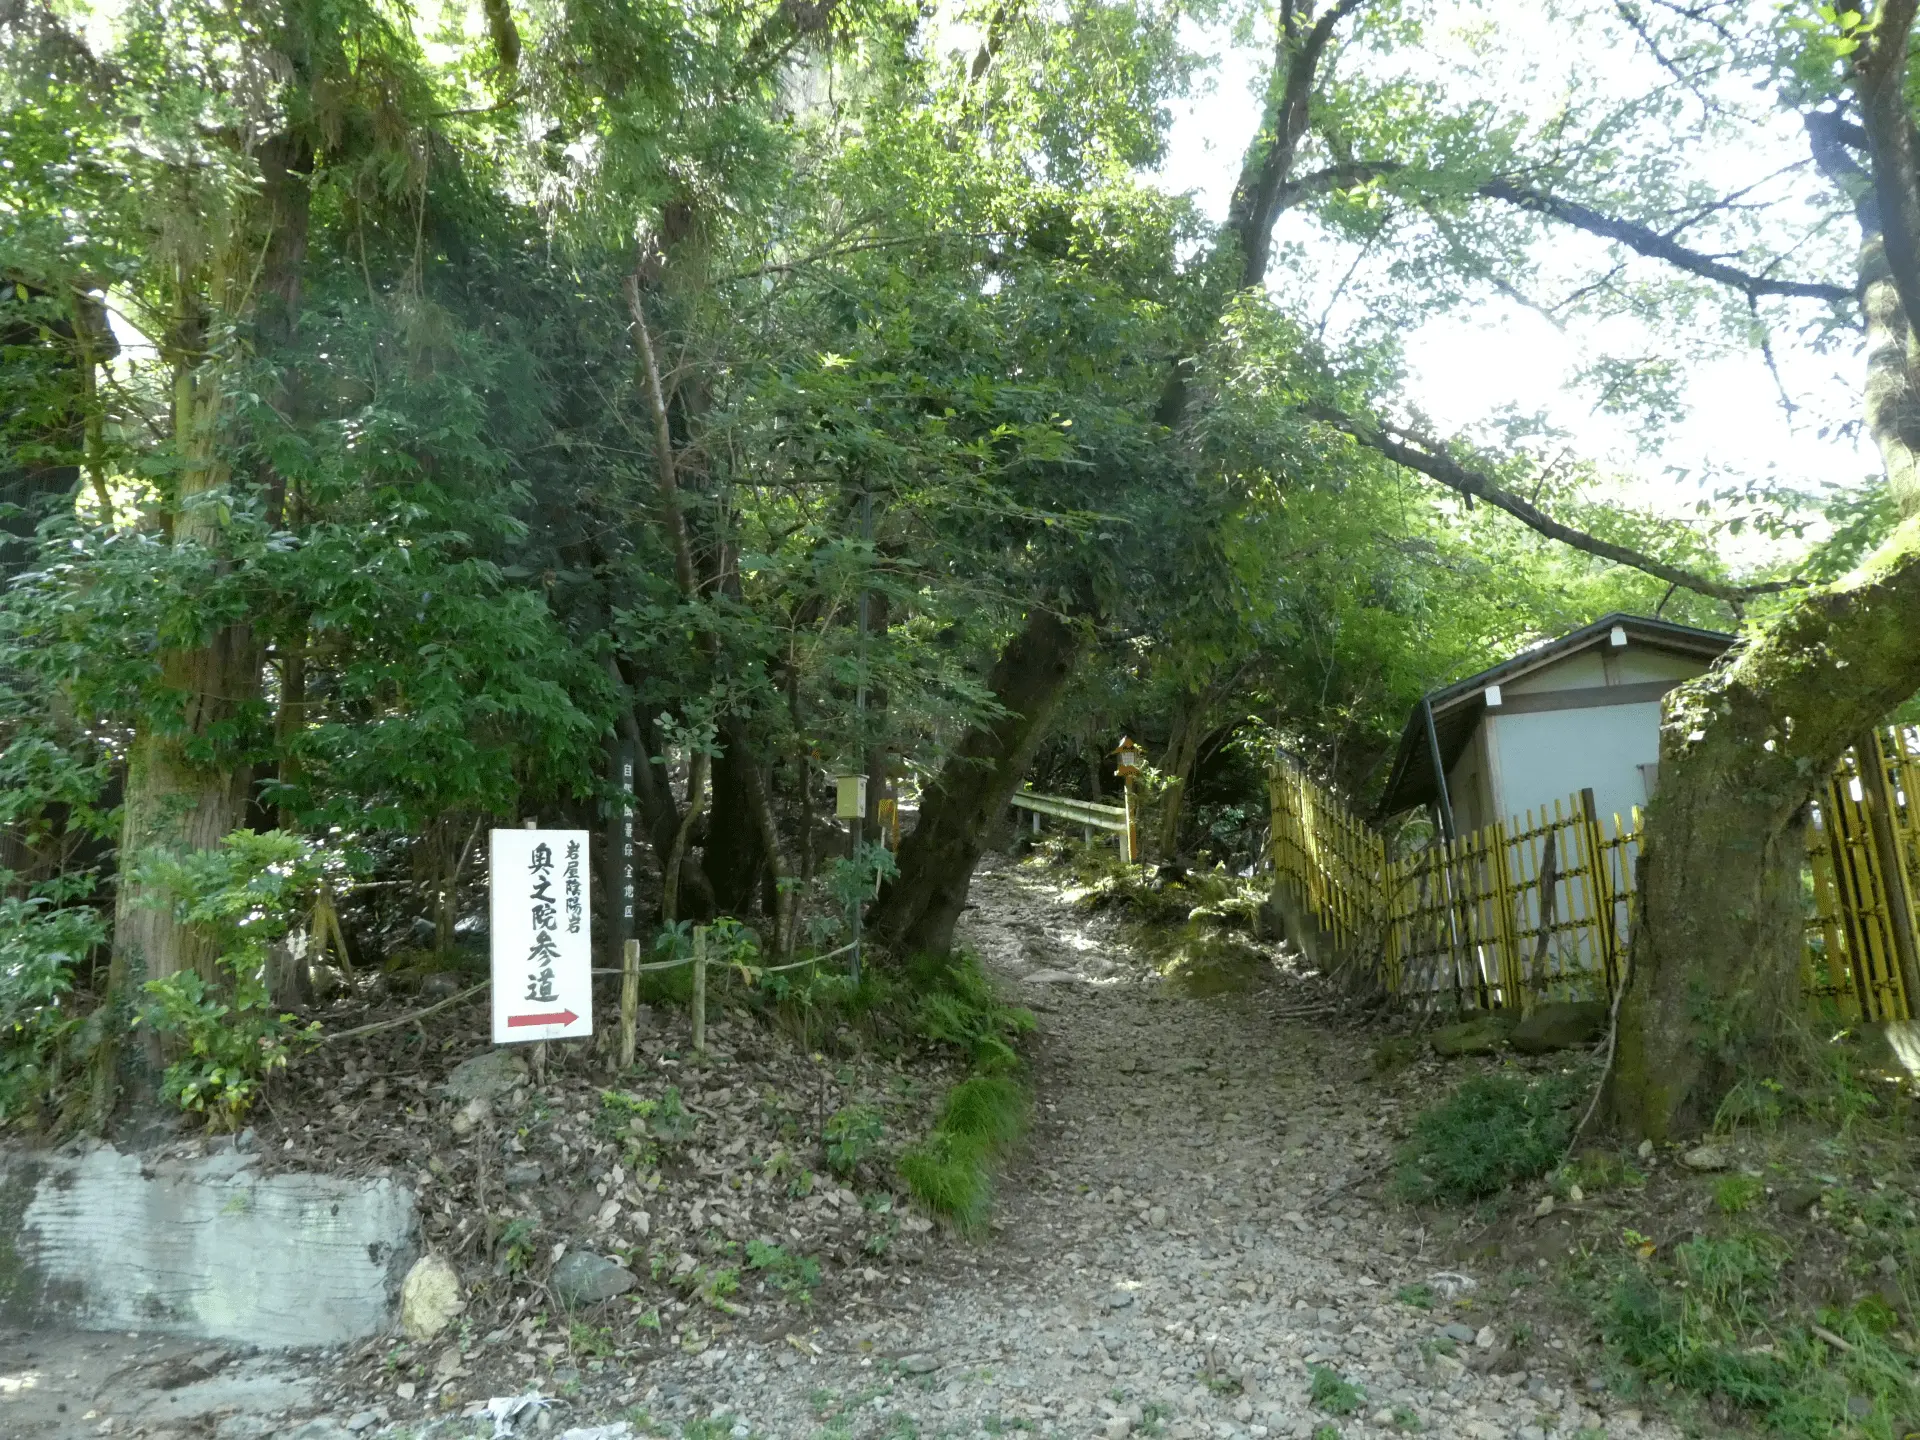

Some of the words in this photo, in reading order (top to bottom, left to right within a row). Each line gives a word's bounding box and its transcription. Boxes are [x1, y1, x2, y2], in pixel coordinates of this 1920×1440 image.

[524, 842, 562, 1003] 奥之院参道
[563, 840, 583, 934] 岩屋陰陽岩
